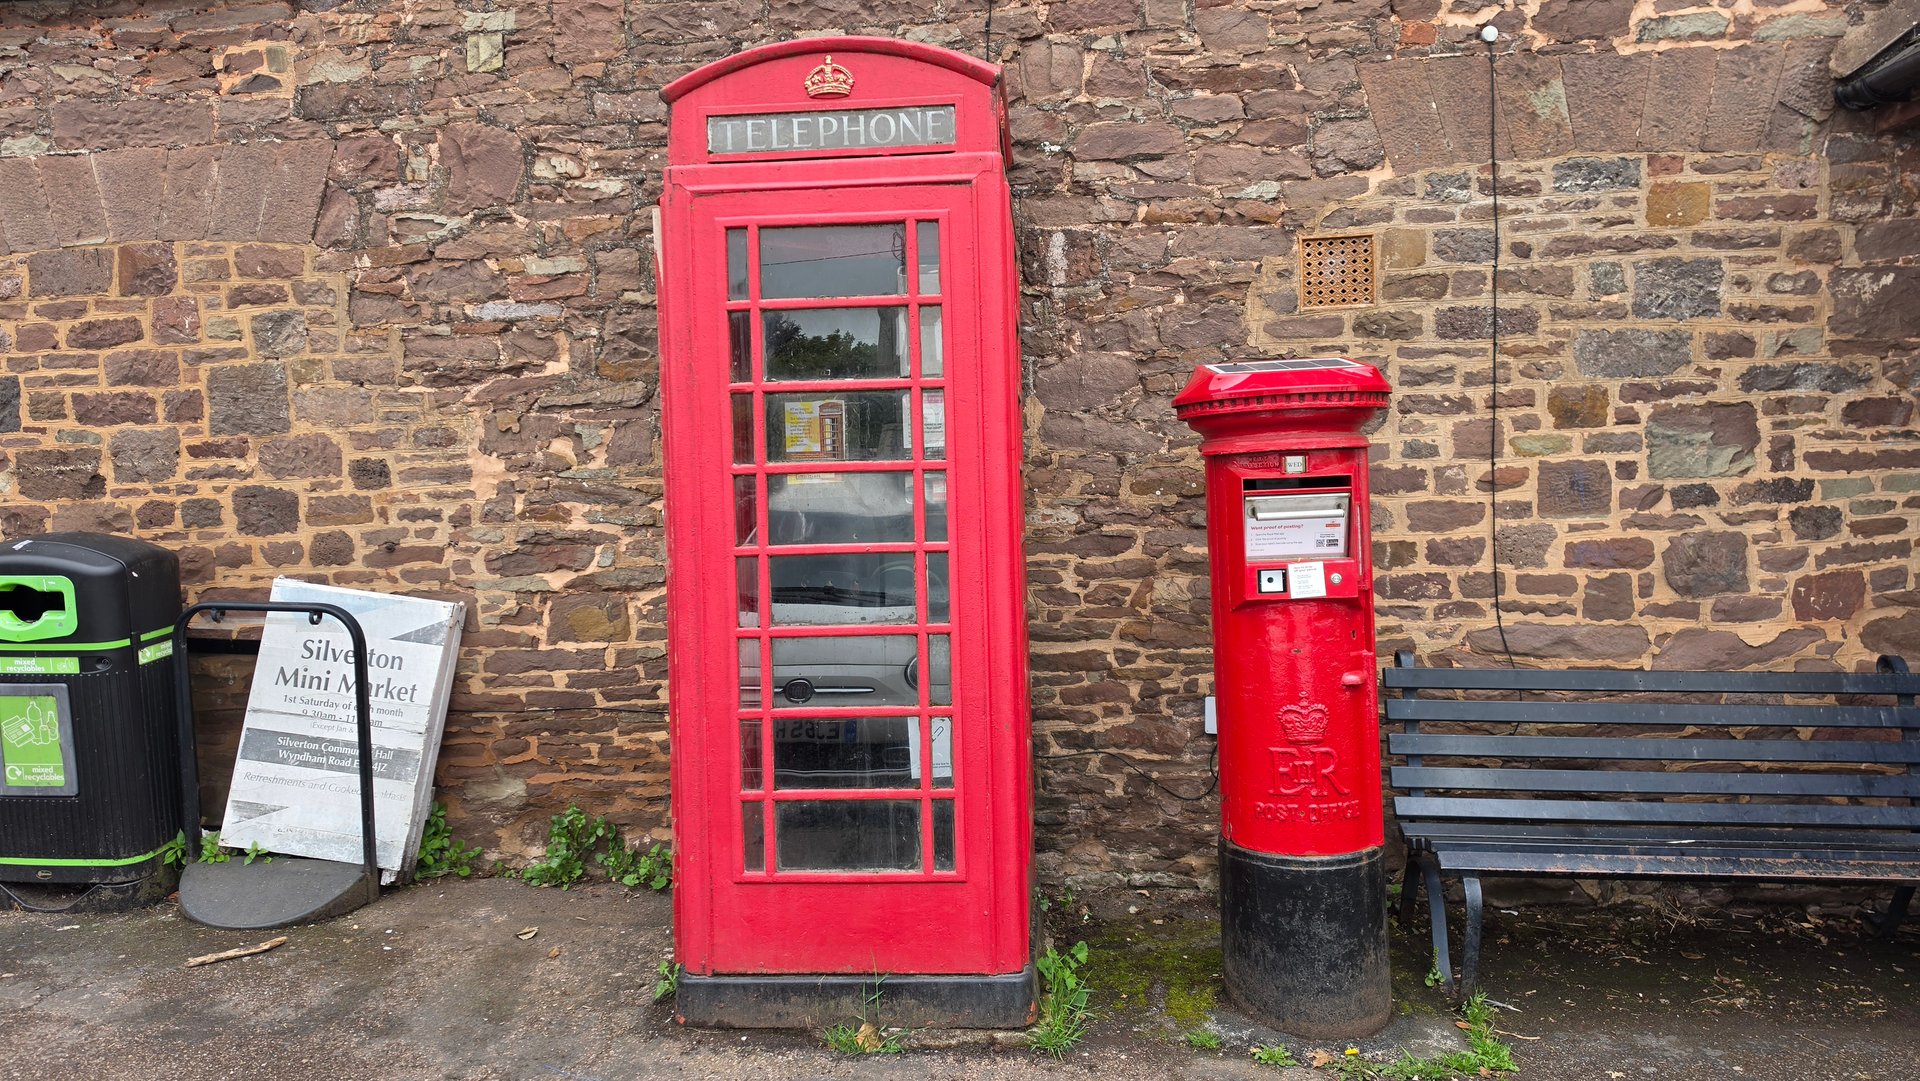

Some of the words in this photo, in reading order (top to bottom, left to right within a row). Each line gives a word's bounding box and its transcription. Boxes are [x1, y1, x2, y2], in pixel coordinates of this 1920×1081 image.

[717, 110, 946, 150] TELEPHONE
[14, 658, 36, 666] mixed
[300, 639, 403, 671] Silveton
[6, 664, 46, 673] recyclables
[274, 665, 332, 692] Mini
[283, 694, 297, 704] 1st
[298, 695, 341, 710] Saturday
[341, 700, 354, 710] of
[375, 706, 404, 718] month
[276, 736, 320, 753] Silverton
[375, 747, 394, 761] Hall
[278, 750, 328, 765] Wyndham
[327, 756, 352, 768] Road
[24, 773, 65, 783] recyclables
[244, 772, 307, 788] Refreshments
[307, 780, 328, 791] and
[1253, 801, 1299, 821] POST
[1308, 799, 1361, 822] OFFICE
